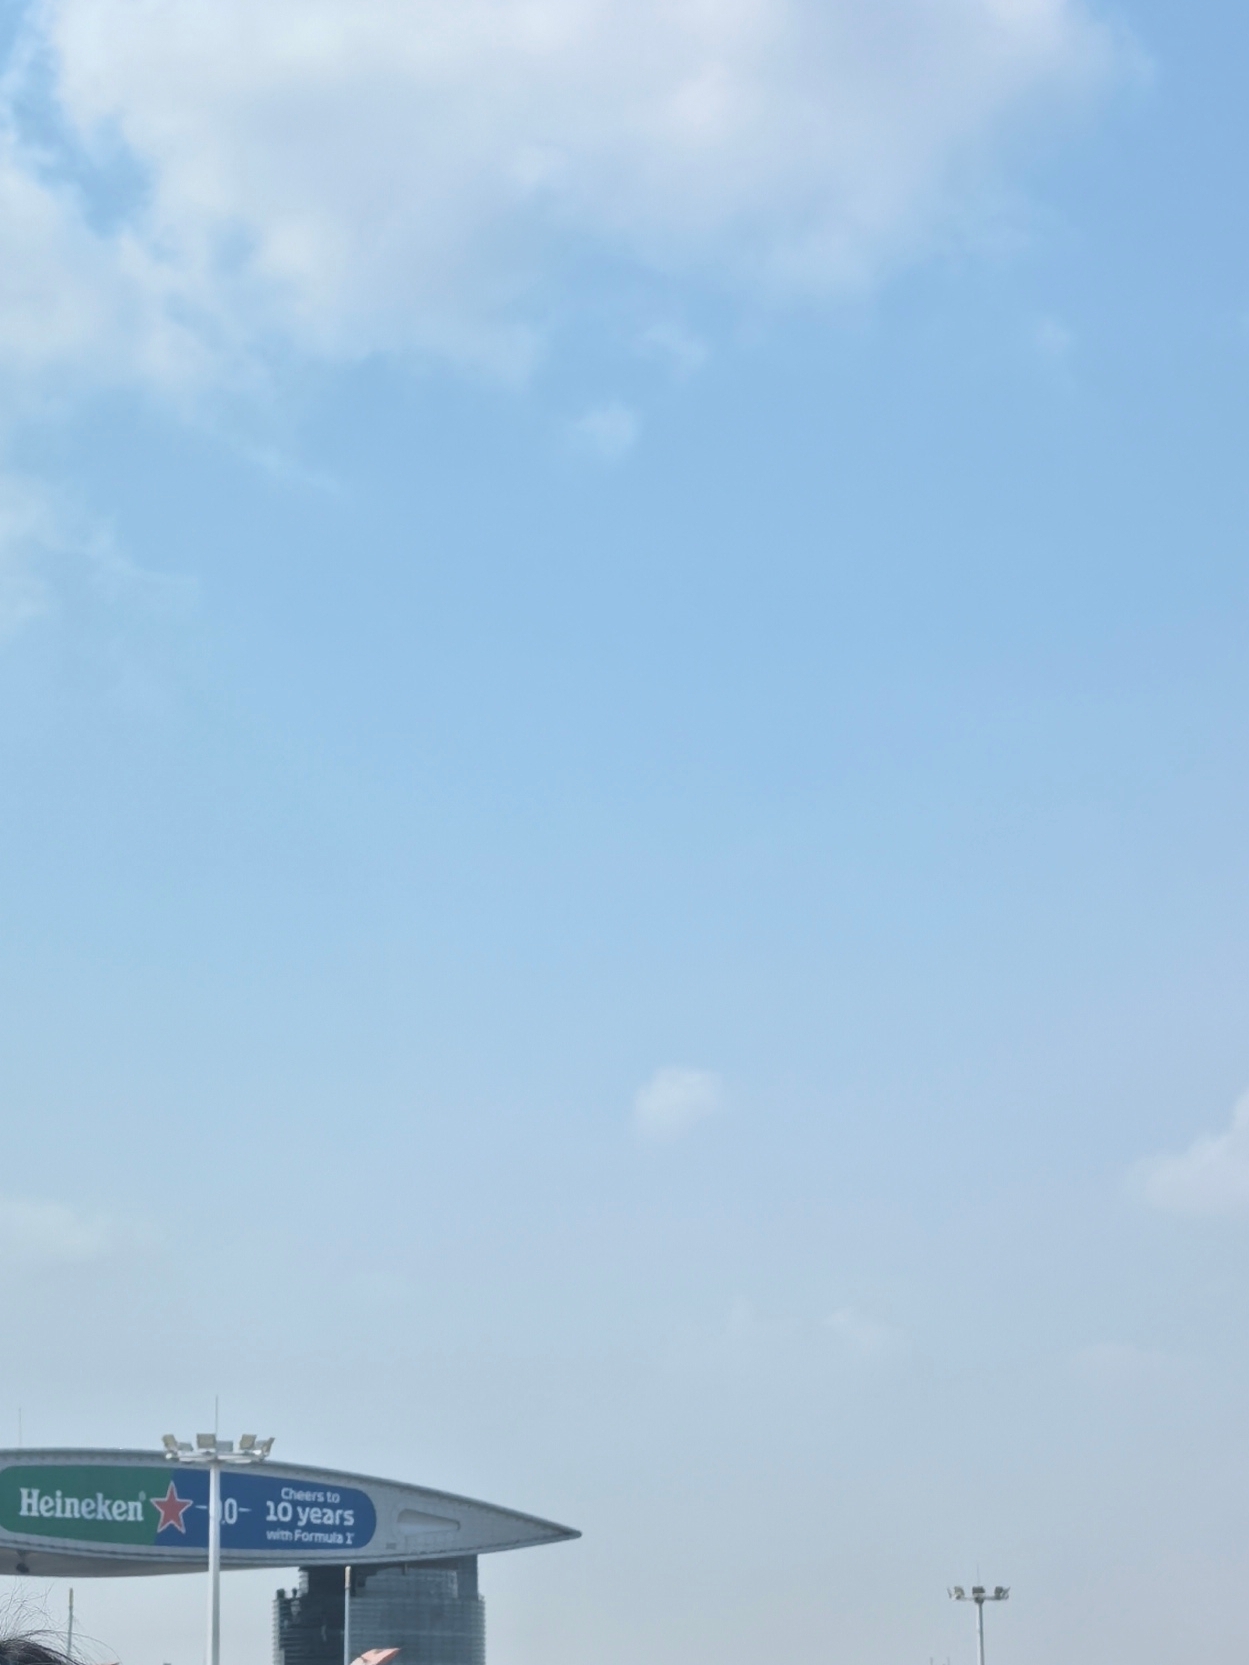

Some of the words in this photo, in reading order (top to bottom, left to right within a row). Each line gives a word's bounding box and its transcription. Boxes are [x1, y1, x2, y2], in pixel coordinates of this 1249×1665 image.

[19, 1487, 144, 1522] Heineken
[281, 1487, 324, 1502] Cheers
[326, 1491, 340, 1504] to
[266, 1500, 293, 1522] 10
[296, 1505, 355, 1527] years
[266, 1528, 293, 1541] with
[294, 1529, 344, 1544] Formula
